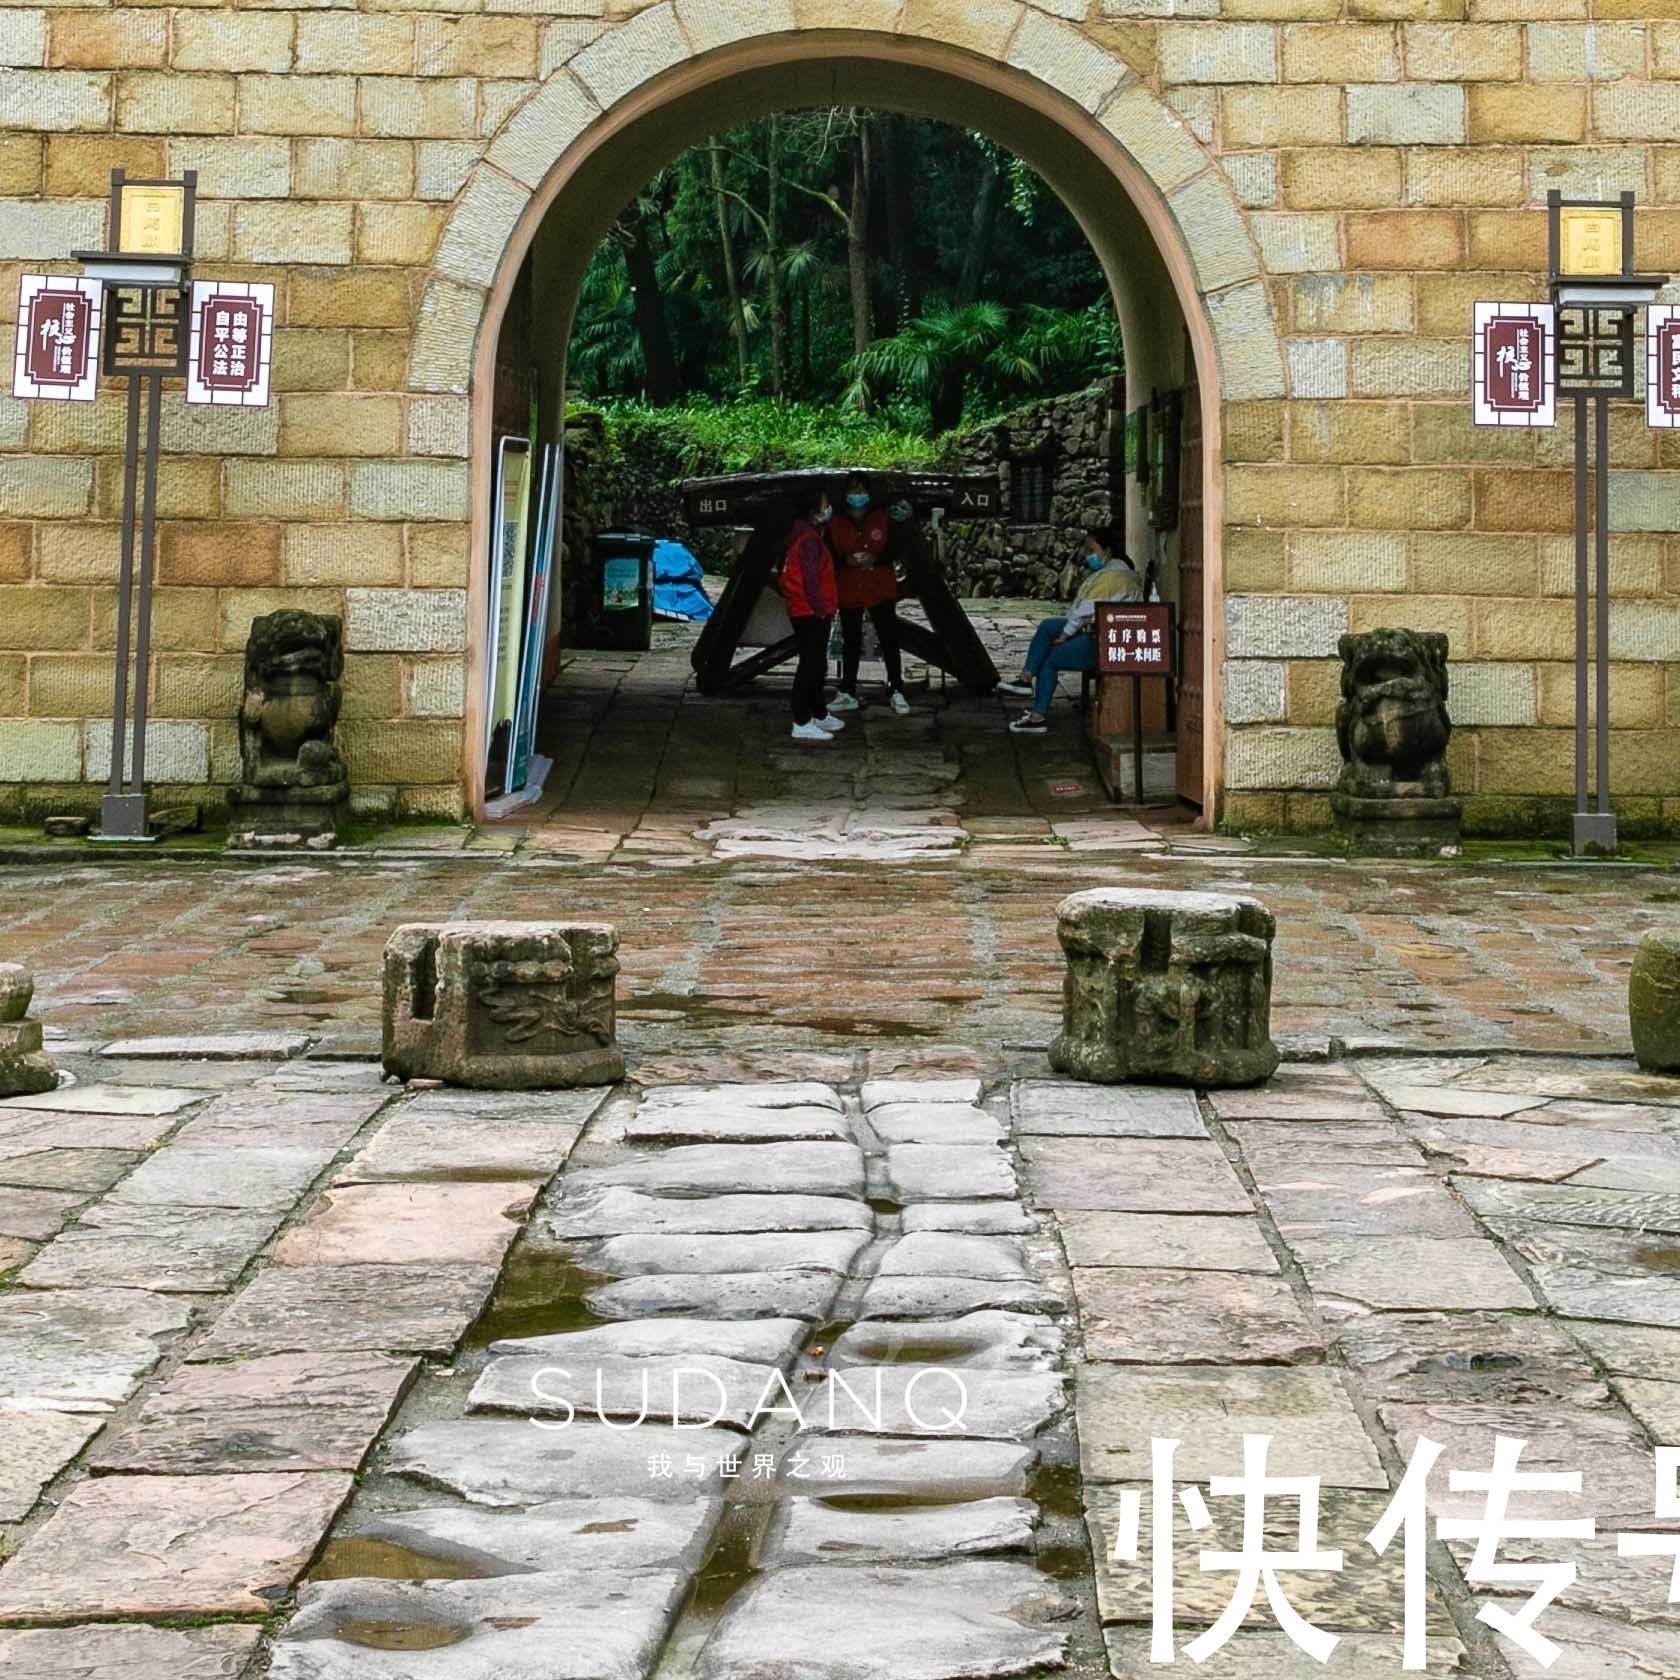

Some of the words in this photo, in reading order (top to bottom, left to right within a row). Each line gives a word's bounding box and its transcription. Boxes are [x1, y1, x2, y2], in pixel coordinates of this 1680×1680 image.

[215, 310, 248, 327] 自由
[214, 327, 248, 343] 平等
[213, 343, 246, 359] 公正
[212, 359, 246, 376] 法治
[699, 498, 727, 513] 出口
[961, 491, 990, 507] 入口
[1107, 628, 1161, 644] 有序购票
[1108, 646, 1162, 662] 保持一米间距
